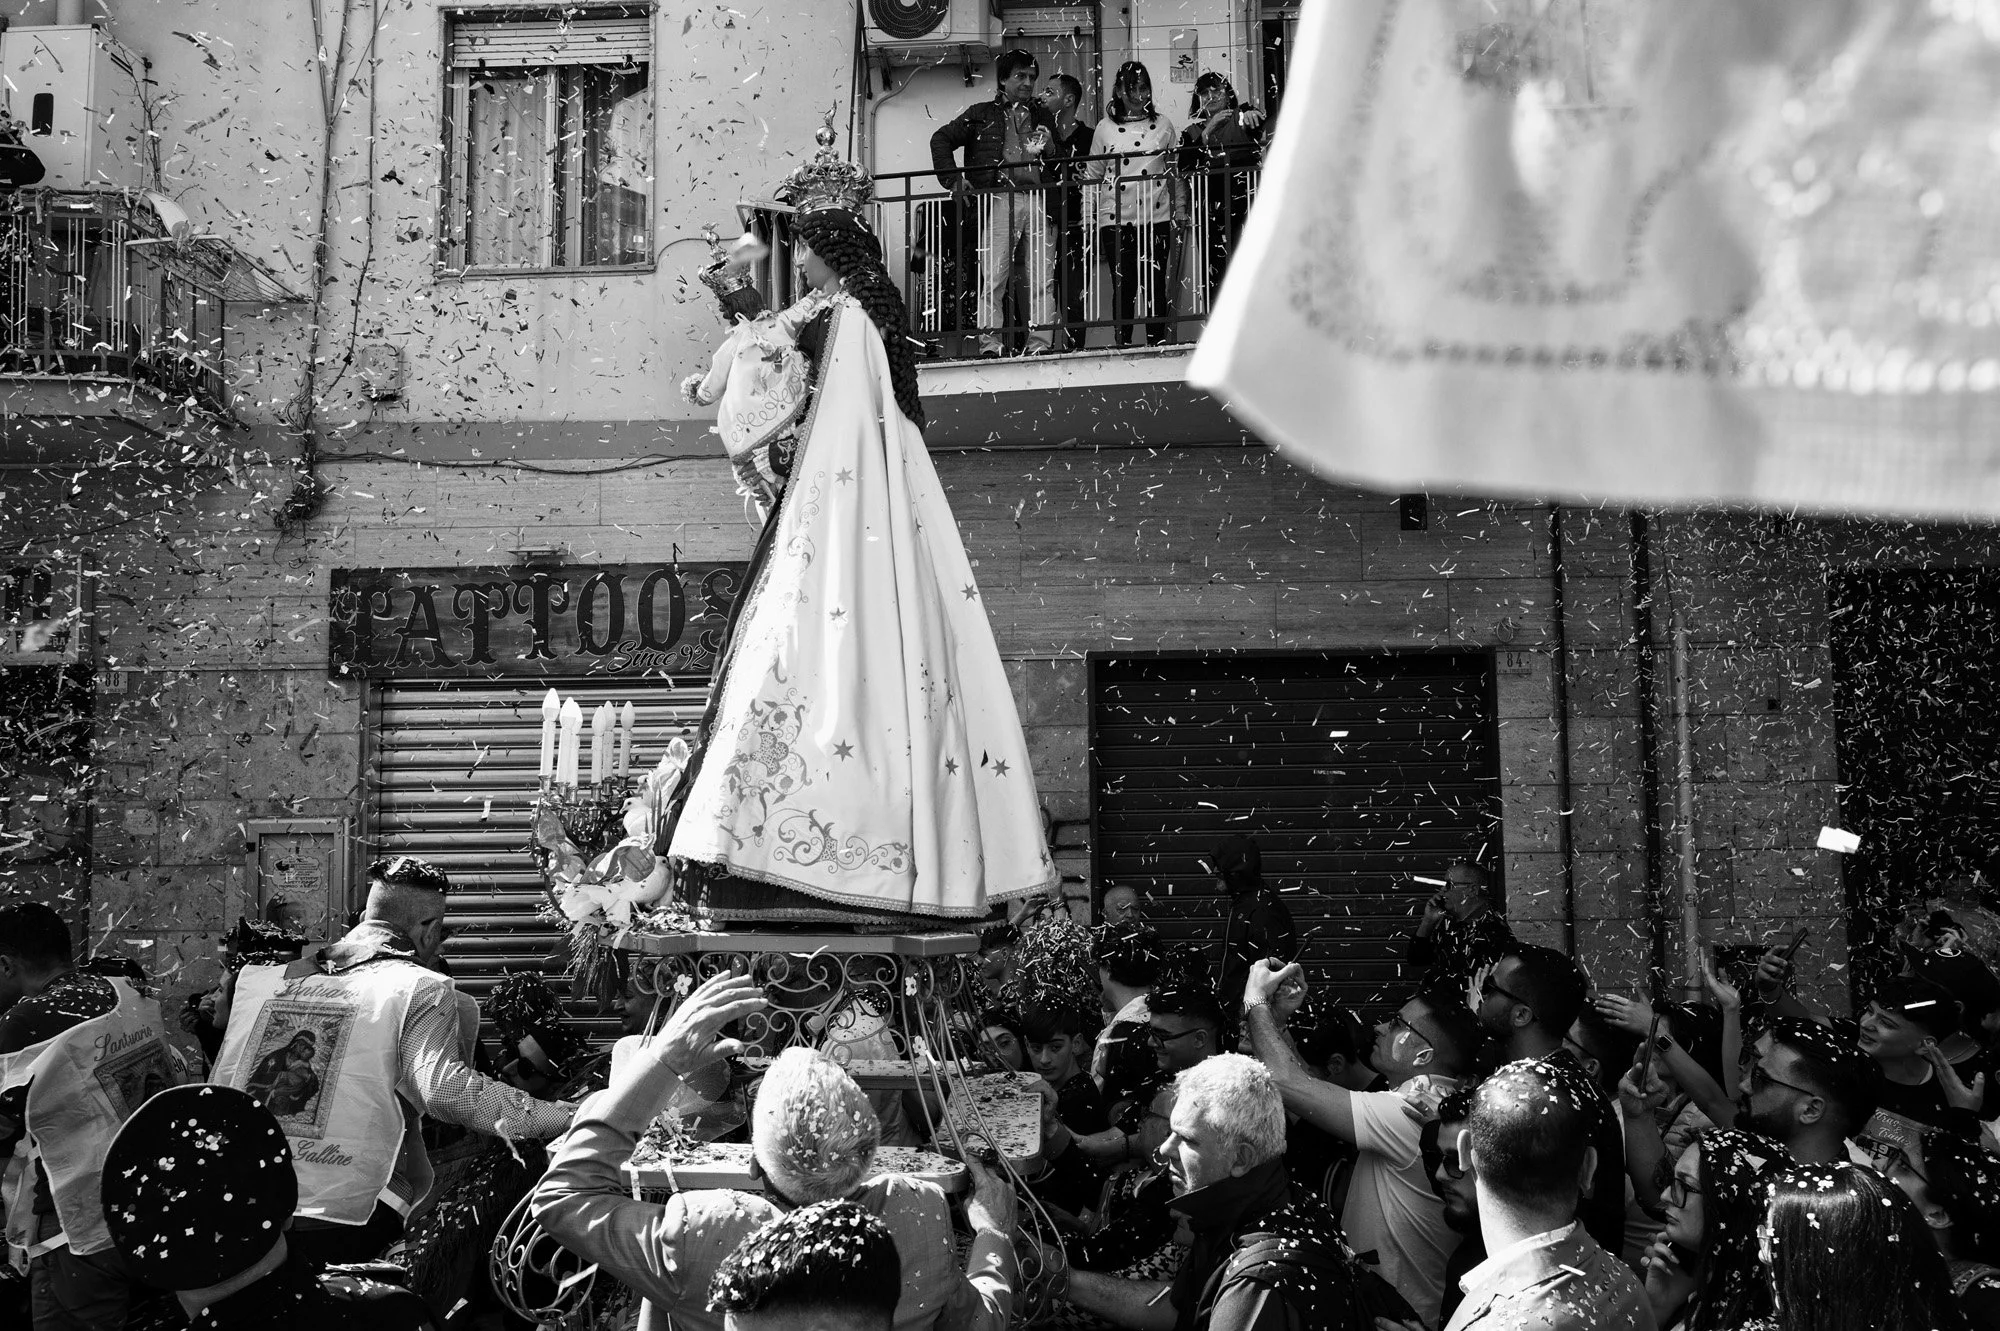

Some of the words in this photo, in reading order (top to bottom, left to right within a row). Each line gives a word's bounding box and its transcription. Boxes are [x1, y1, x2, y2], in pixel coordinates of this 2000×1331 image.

[606, 640, 678, 673] Since
[680, 643, 710, 671] 92
[1506, 652, 1523, 668] 84
[104, 672, 120, 688] 88
[292, 1140, 353, 1166] Galline
